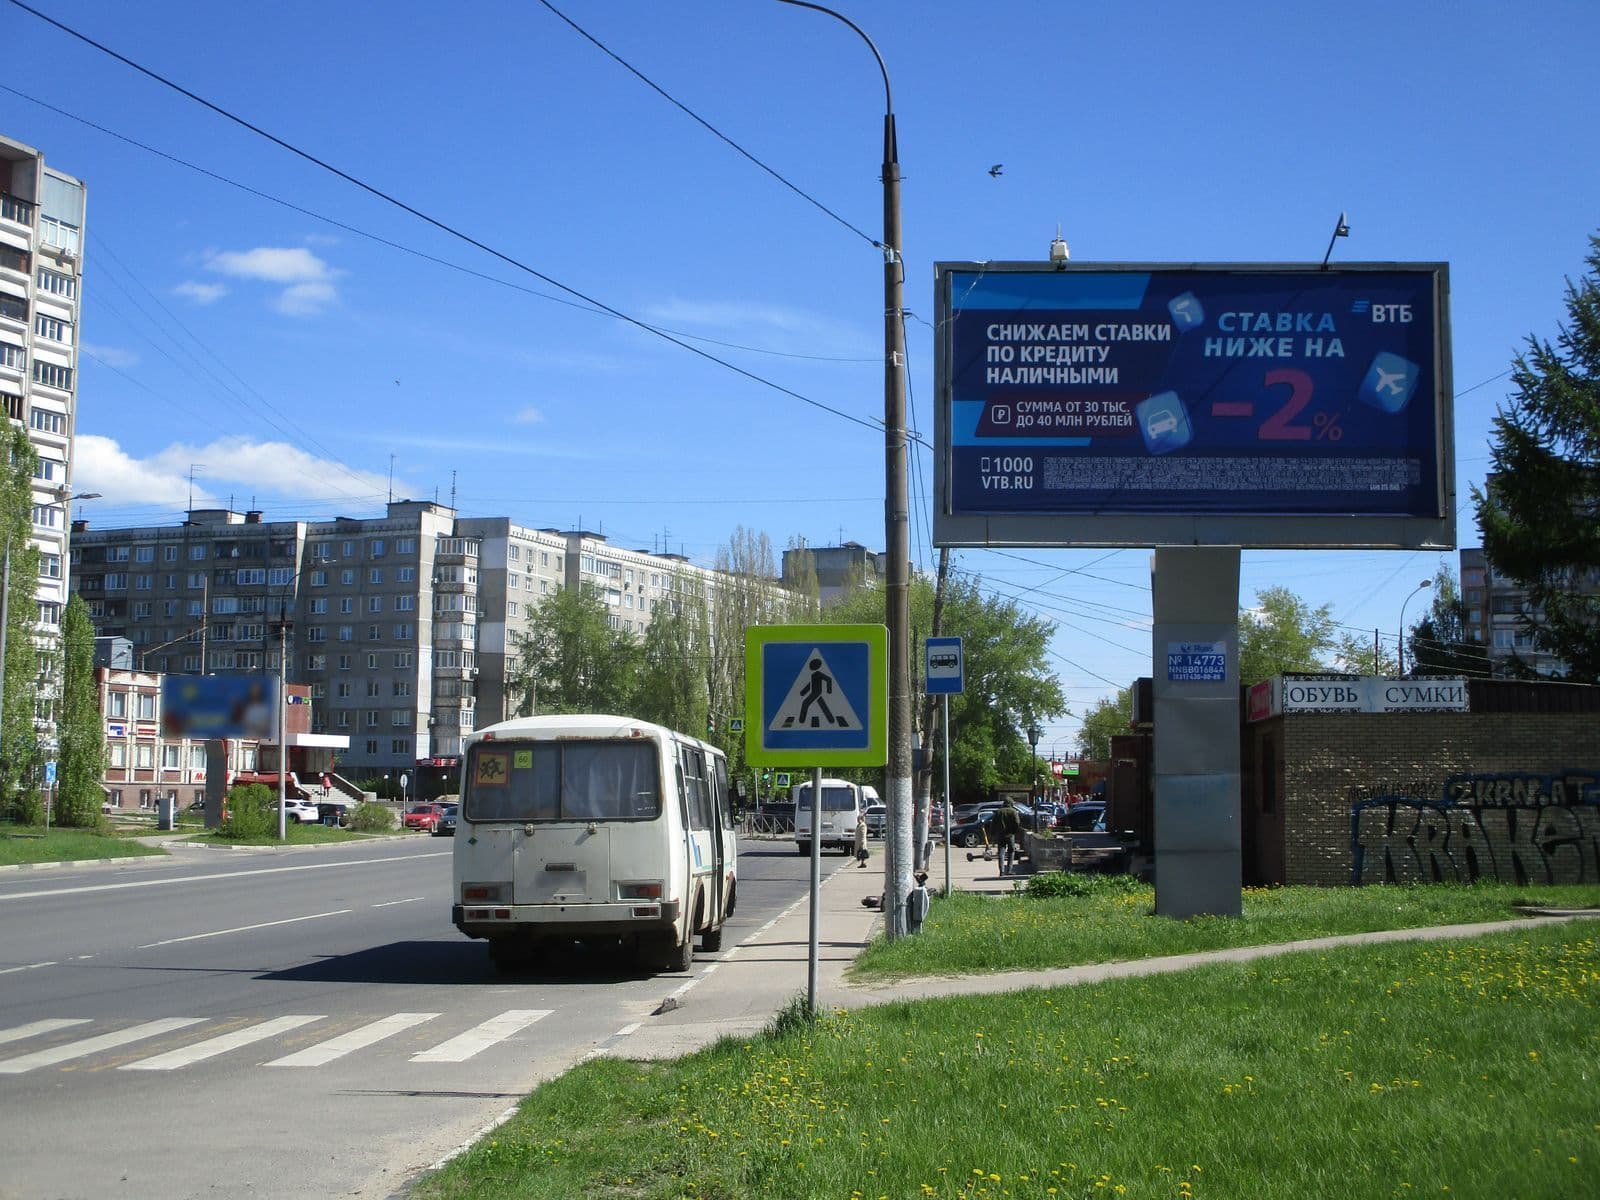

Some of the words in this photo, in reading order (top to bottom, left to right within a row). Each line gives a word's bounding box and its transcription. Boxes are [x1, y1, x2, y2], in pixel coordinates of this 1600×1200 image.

[1218, 312, 1336, 332] СТАВКА
[1372, 304, 1413, 323] ВТБ
[986, 324, 1089, 341] СНИЖАЕМ
[1095, 324, 1171, 341] СТАВКИ
[986, 345, 1014, 362] ПО
[1020, 345, 1110, 365] КРЕДИТУ
[1204, 337, 1294, 357] НИЖЕ
[1304, 337, 1345, 357] НА
[986, 367, 1118, 384] НАЛИЧНЫМИ
[1016, 401, 1062, 413] СУММА
[1066, 401, 1081, 413] ОТ
[1085, 401, 1099, 413] 30
[1102, 401, 1130, 413] ТЫС.
[1016, 415, 1033, 428] ДО
[1037, 415, 1052, 426] 40
[1055, 415, 1083, 426] МЛН
[1086, 413, 1132, 426] РУБЛЕЙ
[993, 457, 1033, 473] 1000
[982, 475, 1033, 489] VTB.RU
[1187, 655, 1224, 666] 14773
[1289, 686, 1358, 703] ОБУВЬ
[1385, 686, 1463, 703] СУМКИ
